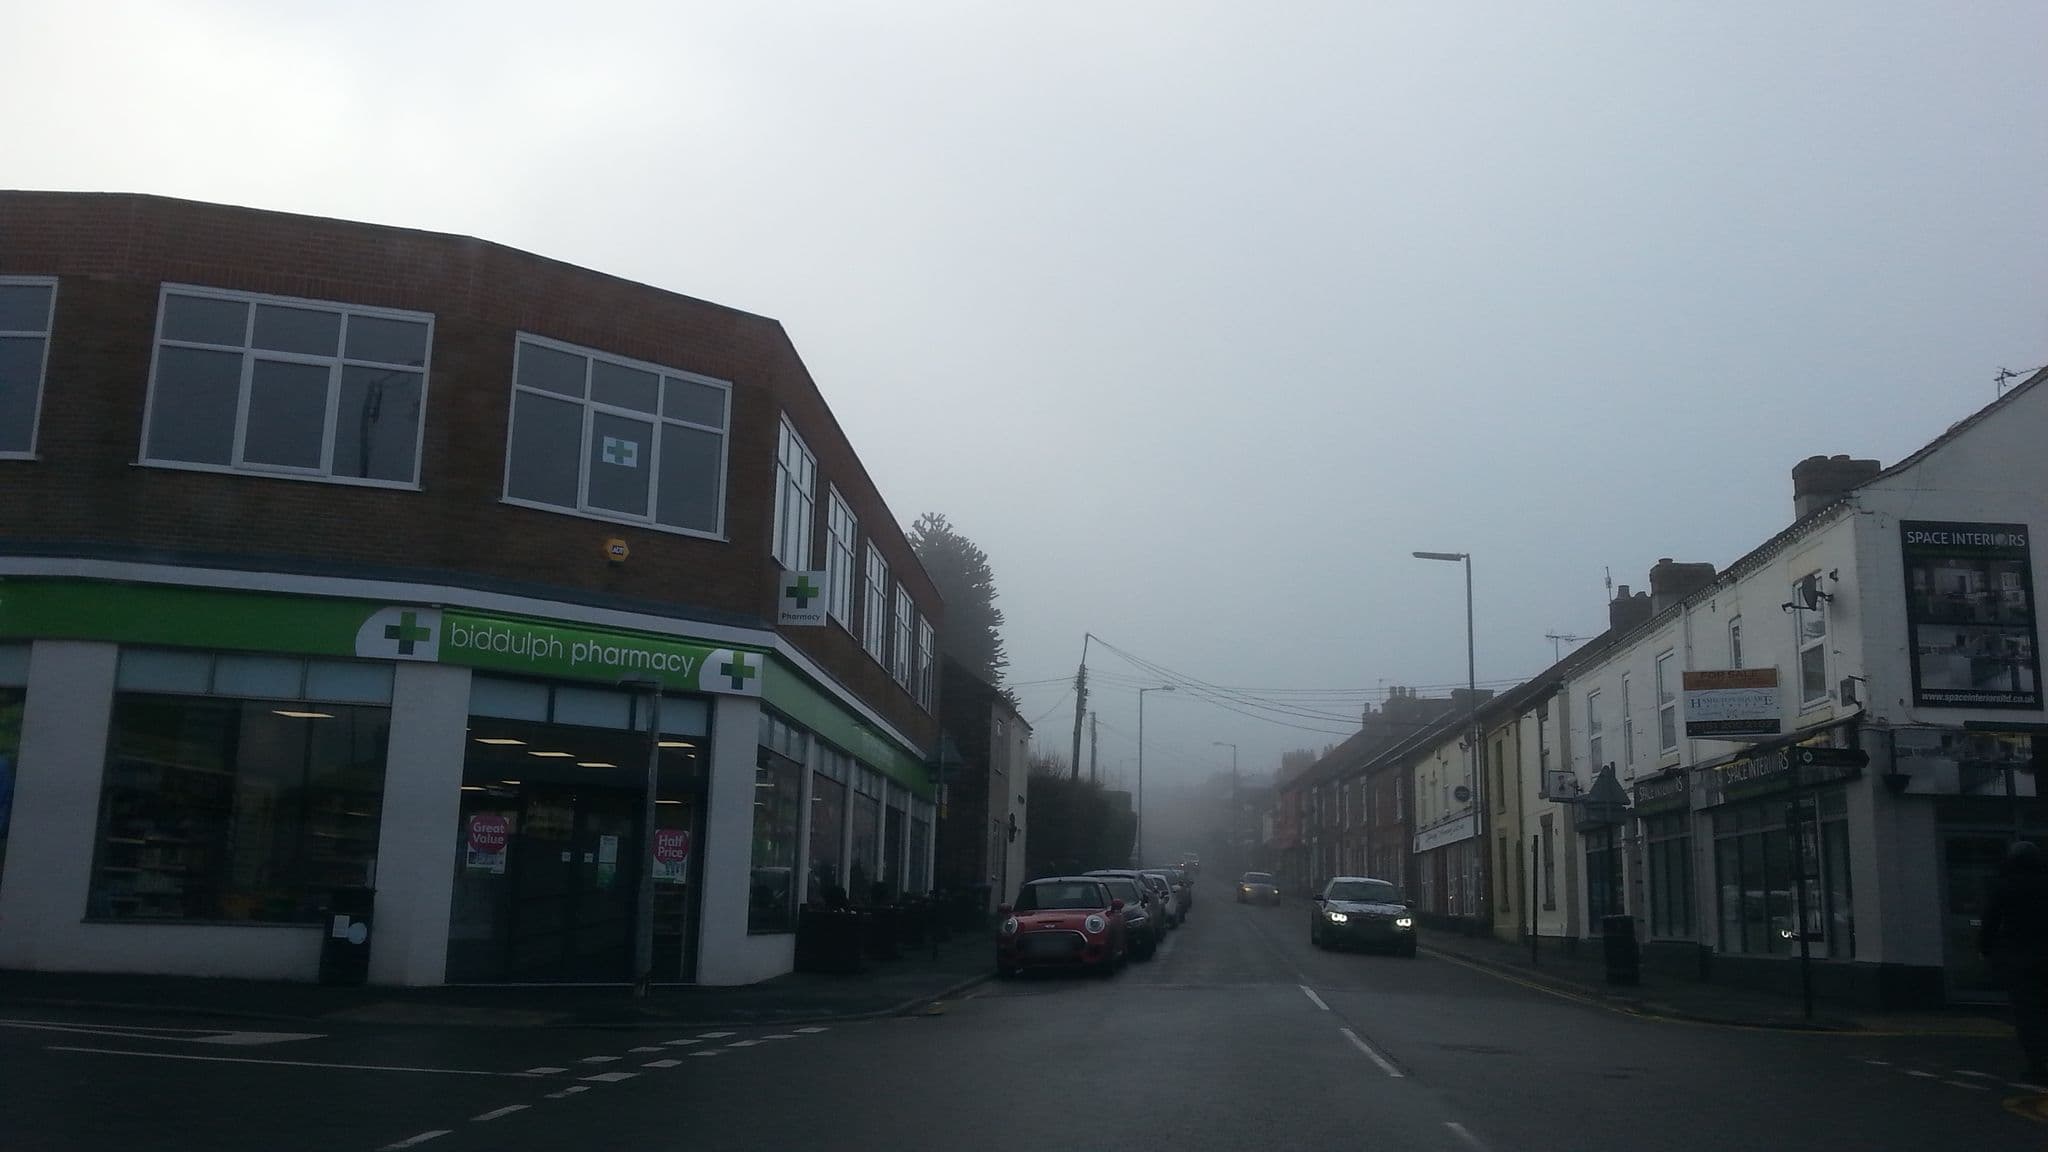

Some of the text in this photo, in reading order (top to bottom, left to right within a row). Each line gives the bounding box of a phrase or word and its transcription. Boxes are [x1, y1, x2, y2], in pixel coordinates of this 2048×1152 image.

[1906, 531, 1949, 545] SPACE
[782, 611, 821, 621] Pharmacy
[450, 622, 694, 678] biddulph pharmacy
[1727, 763, 1749, 784] SPACE
[473, 821, 505, 834] Great
[472, 833, 504, 845] Value
[658, 834, 684, 847] Half
[657, 846, 684, 859] Price
